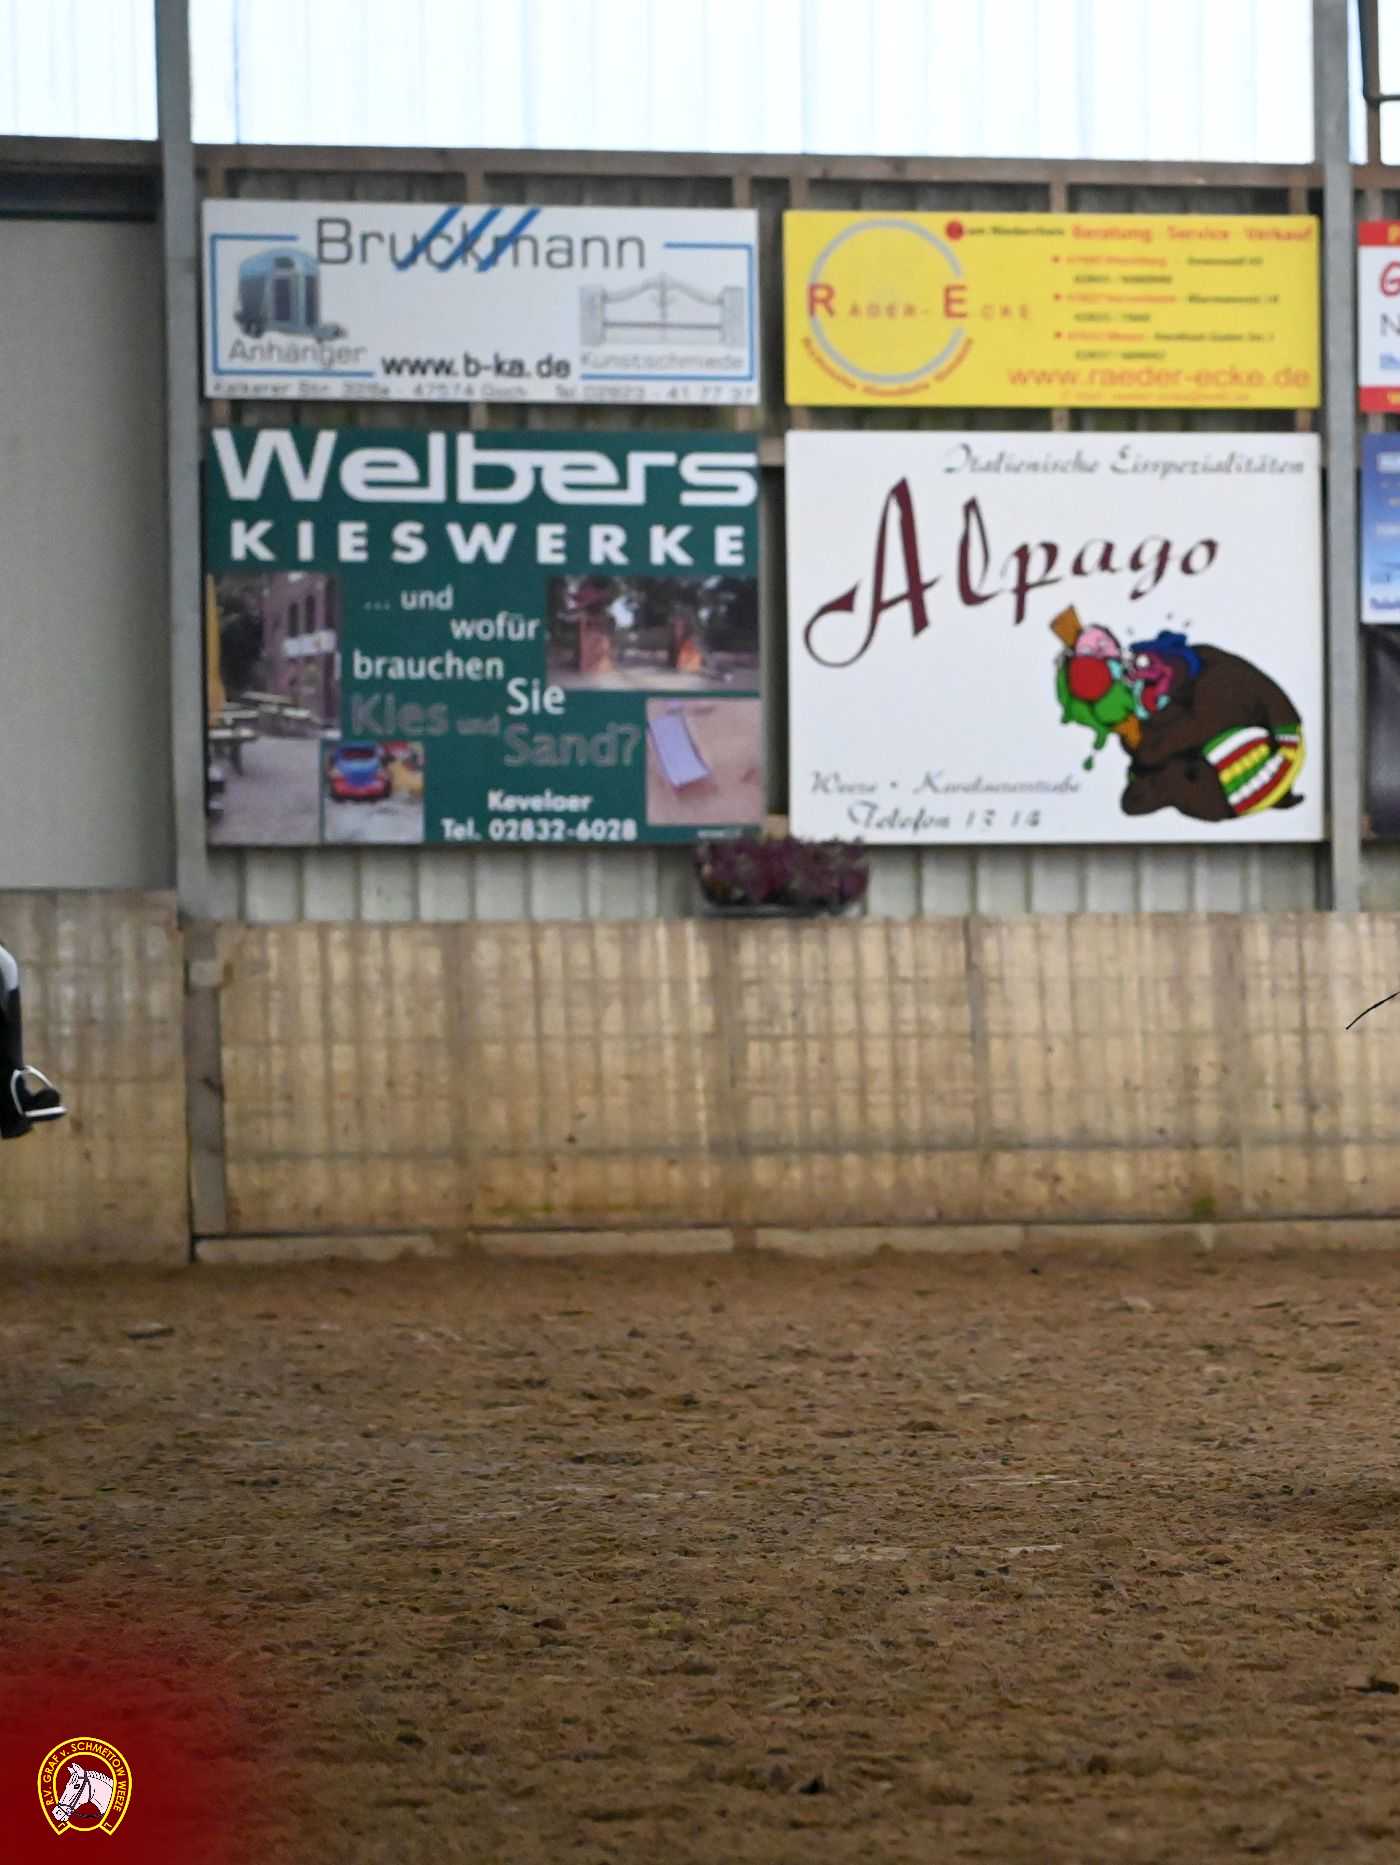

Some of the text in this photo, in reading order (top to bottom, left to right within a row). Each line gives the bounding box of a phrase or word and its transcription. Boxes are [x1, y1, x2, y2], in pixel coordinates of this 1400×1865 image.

[1168, 226, 1230, 241] Service
[381, 352, 571, 379] www.b-ka.de
[1008, 366, 1312, 388] www.raeder-ecke.de
[213, 428, 758, 507] Welbers
[943, 443, 1099, 473] Italienische
[230, 520, 745, 565] KIESWERKE
[803, 477, 1219, 668] Alpago
[400, 584, 454, 610] und
[450, 611, 540, 640] wofür
[352, 649, 567, 715] brauchen Sie
[351, 693, 449, 735] Kies
[504, 721, 640, 767] Sand?
[487, 789, 593, 812] Kevelaer
[441, 819, 638, 841] Tel. 02832-6028
[847, 800, 951, 833] Telefon
